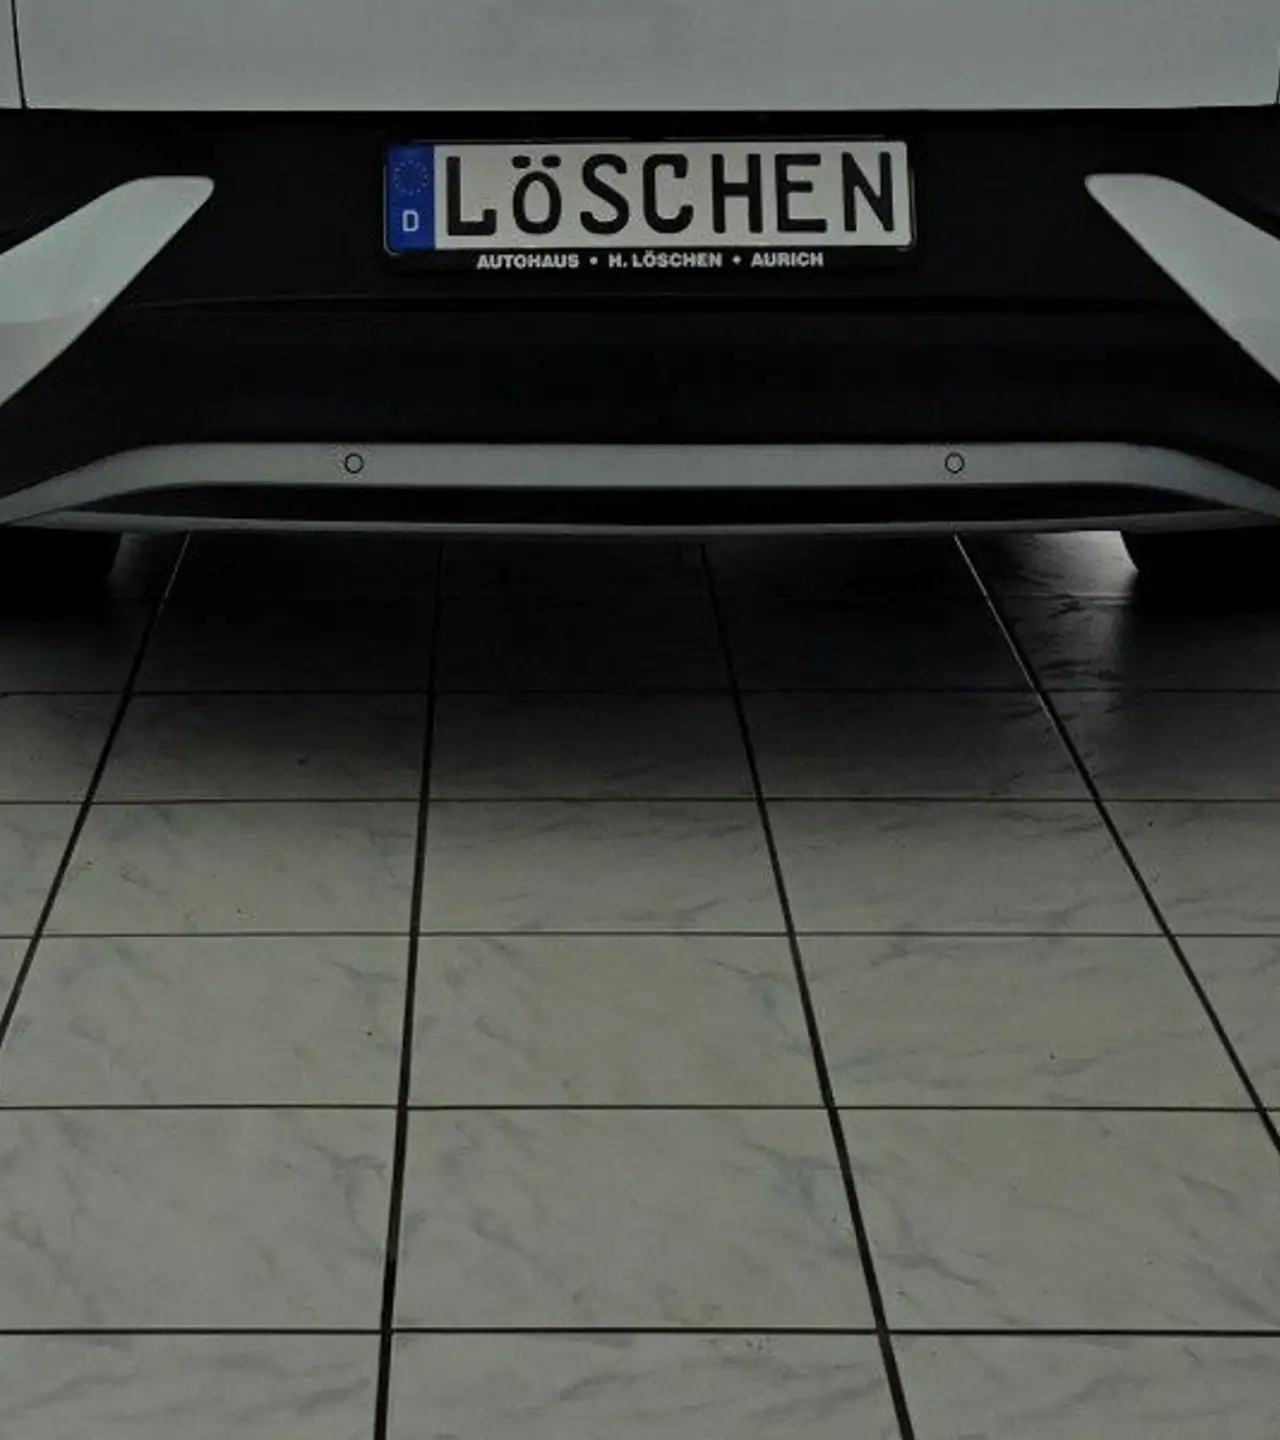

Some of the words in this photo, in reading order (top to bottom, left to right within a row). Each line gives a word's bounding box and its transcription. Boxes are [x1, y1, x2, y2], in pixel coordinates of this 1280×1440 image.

[446, 152, 895, 236] LÖSCHEN
[401, 209, 420, 232] D
[476, 252, 581, 269] AUTOHAUS
[608, 251, 628, 268] H.
[632, 248, 723, 268] LÖSCHEN
[751, 251, 825, 268] AURICH
